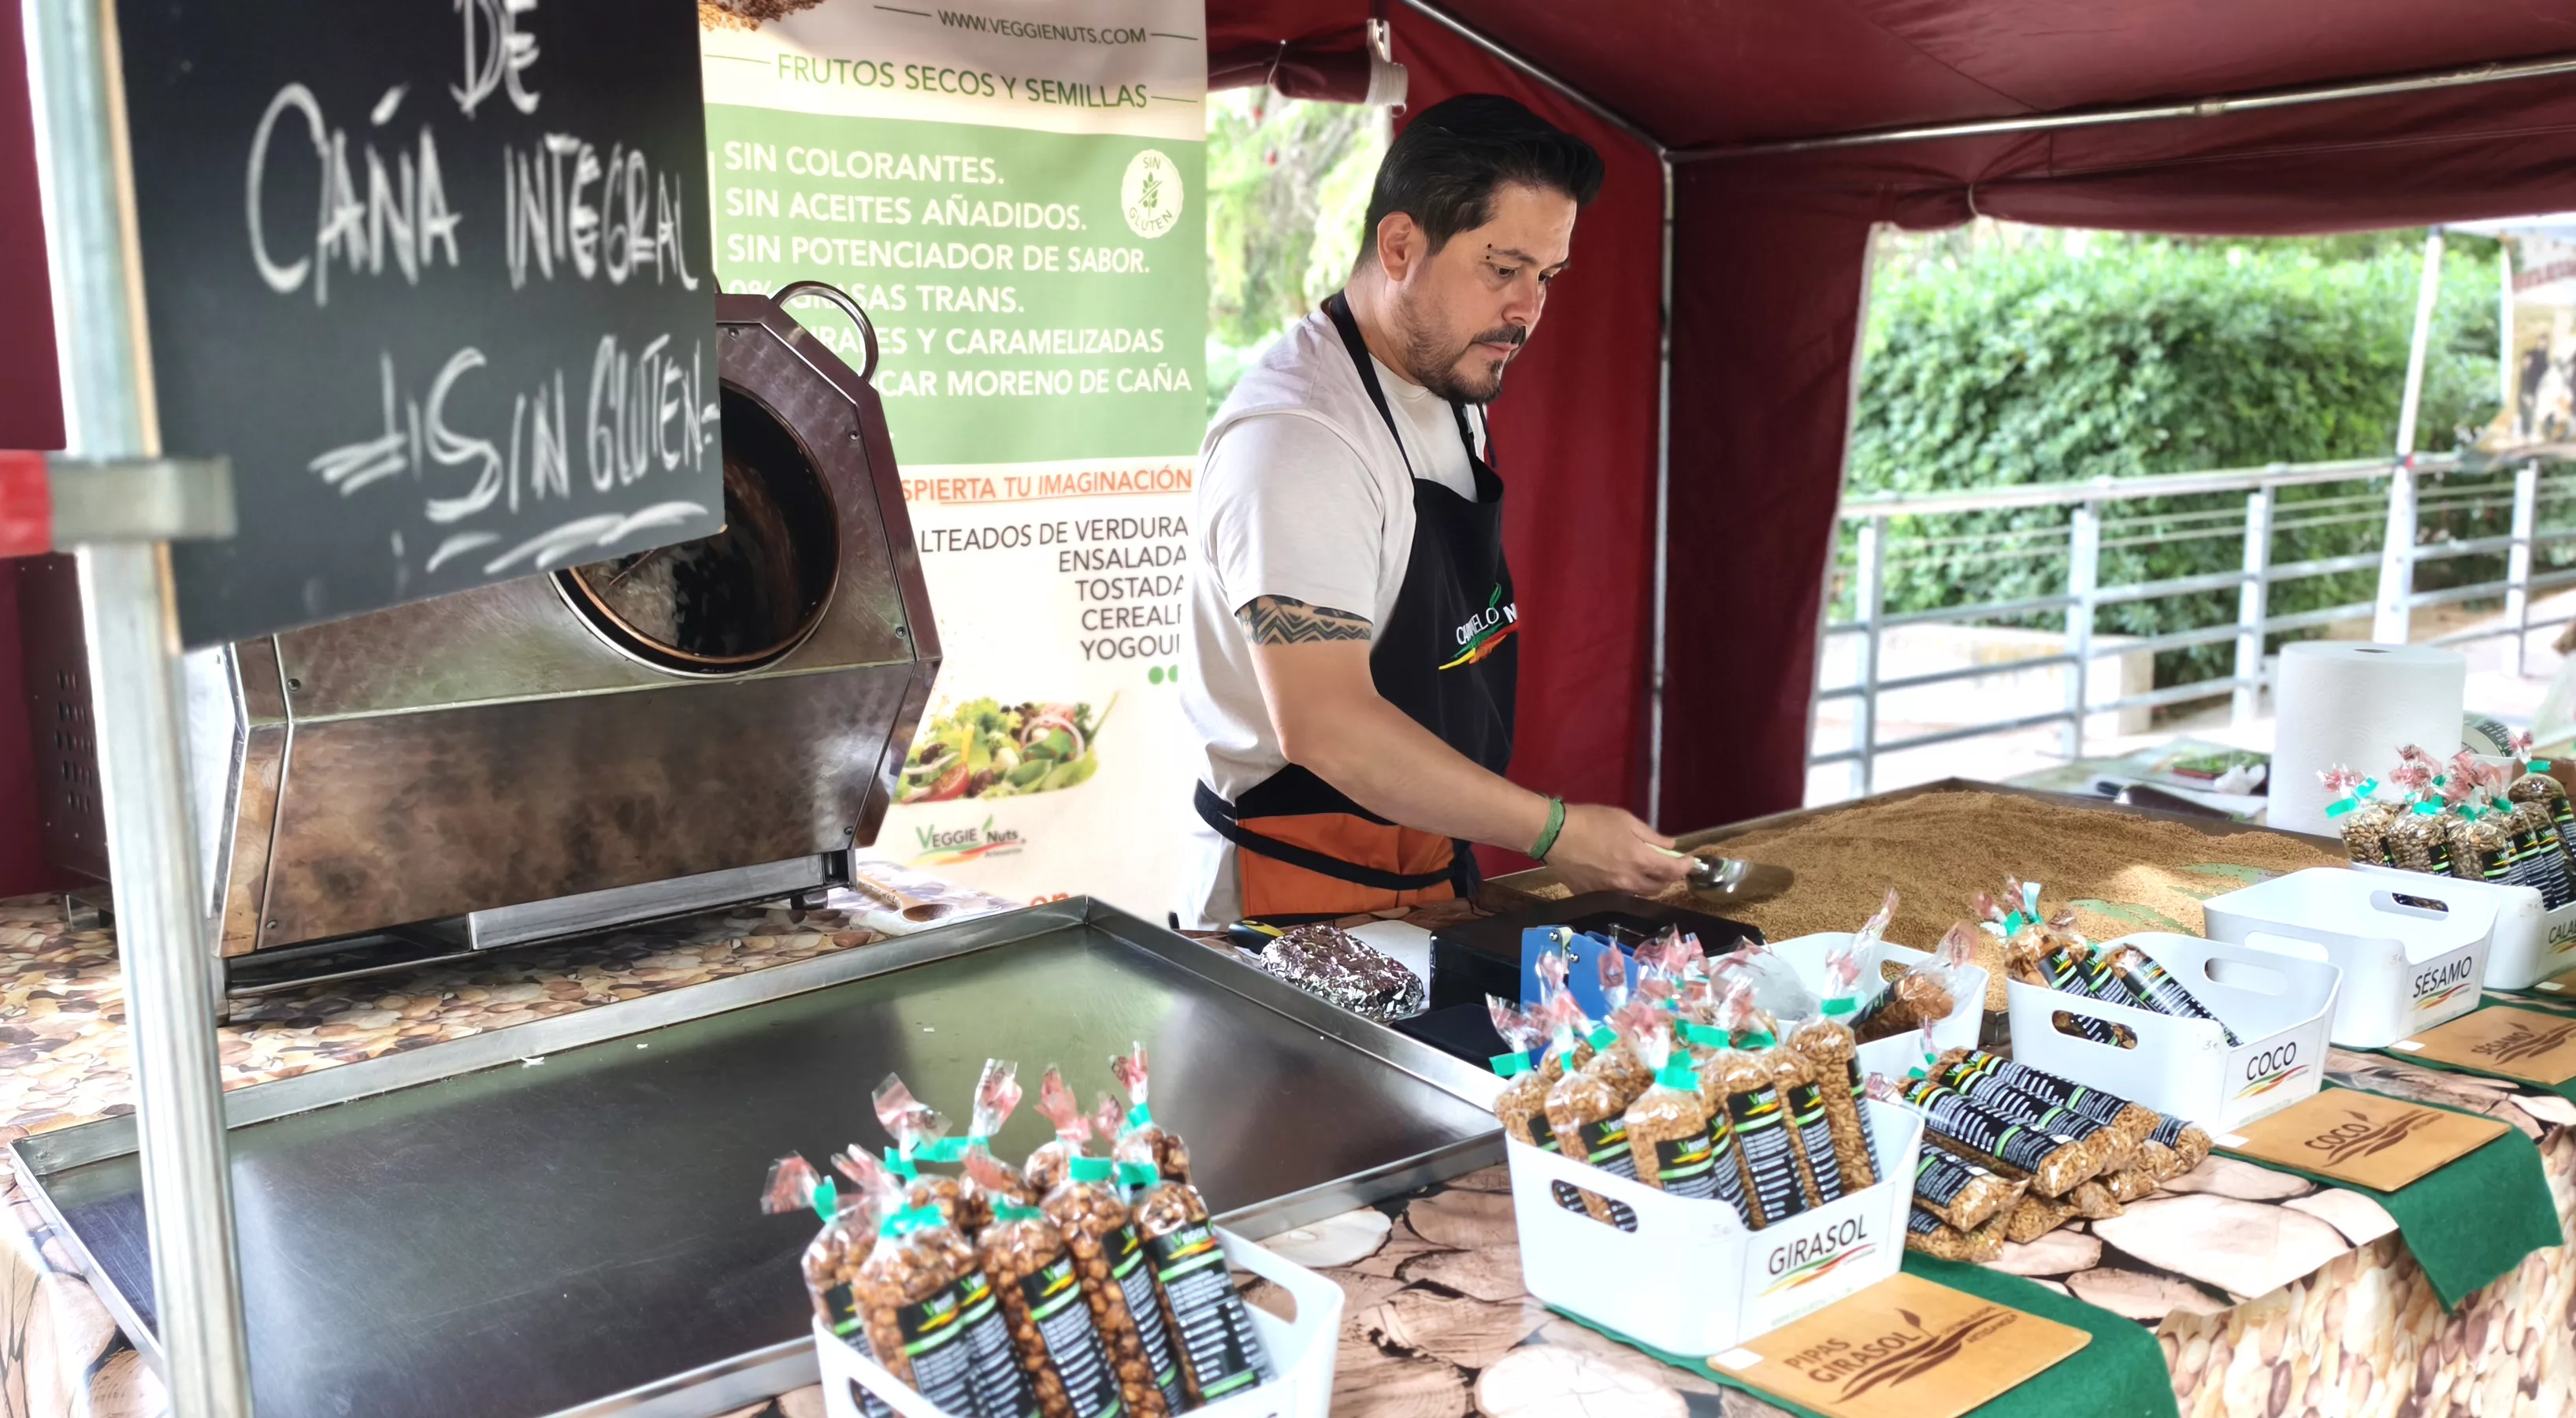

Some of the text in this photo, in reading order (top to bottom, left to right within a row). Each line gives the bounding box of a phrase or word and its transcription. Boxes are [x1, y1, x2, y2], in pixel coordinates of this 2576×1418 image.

[937, 9, 1147, 45] WWW.VEGGIENUTS.COM
[448, 0, 540, 120] DE
[778, 53, 1148, 108] FRUTOS SECOS Y SEMILLAS
[724, 140, 1004, 184] SIN COLORANTES.
[1143, 156, 1161, 169] SIN
[504, 132, 700, 291] INTEGRAL
[726, 187, 1087, 231] SIN ACEITES AÑADIDOS.
[1129, 207, 1173, 231] GLUTEN
[727, 233, 1150, 273] SIN POTENCIADOR DE SABOR.
[915, 284, 1024, 314] TRANS.
[916, 328, 937, 354] Y
[946, 327, 1164, 354] CARAMELIZADAS
[947, 369, 1073, 396] MORENO
[1079, 368, 1110, 393] DE
[1116, 362, 1193, 393] CAÑA
[1004, 476, 1031, 498] TU
[1038, 465, 1192, 496] IMAGINACIÓN
[1040, 521, 1067, 545] DE
[916, 824, 1019, 849] VEGGIE Nuts
[2412, 956, 2473, 998] SÉSAMO
[2247, 1041, 2297, 1080] COCO
[2303, 1123, 2371, 1150] COCO
[1769, 1214, 1869, 1275] GIRASOL
[1783, 1338, 1851, 1370] PIPAS
[1808, 1331, 1922, 1383] GIRASOL
